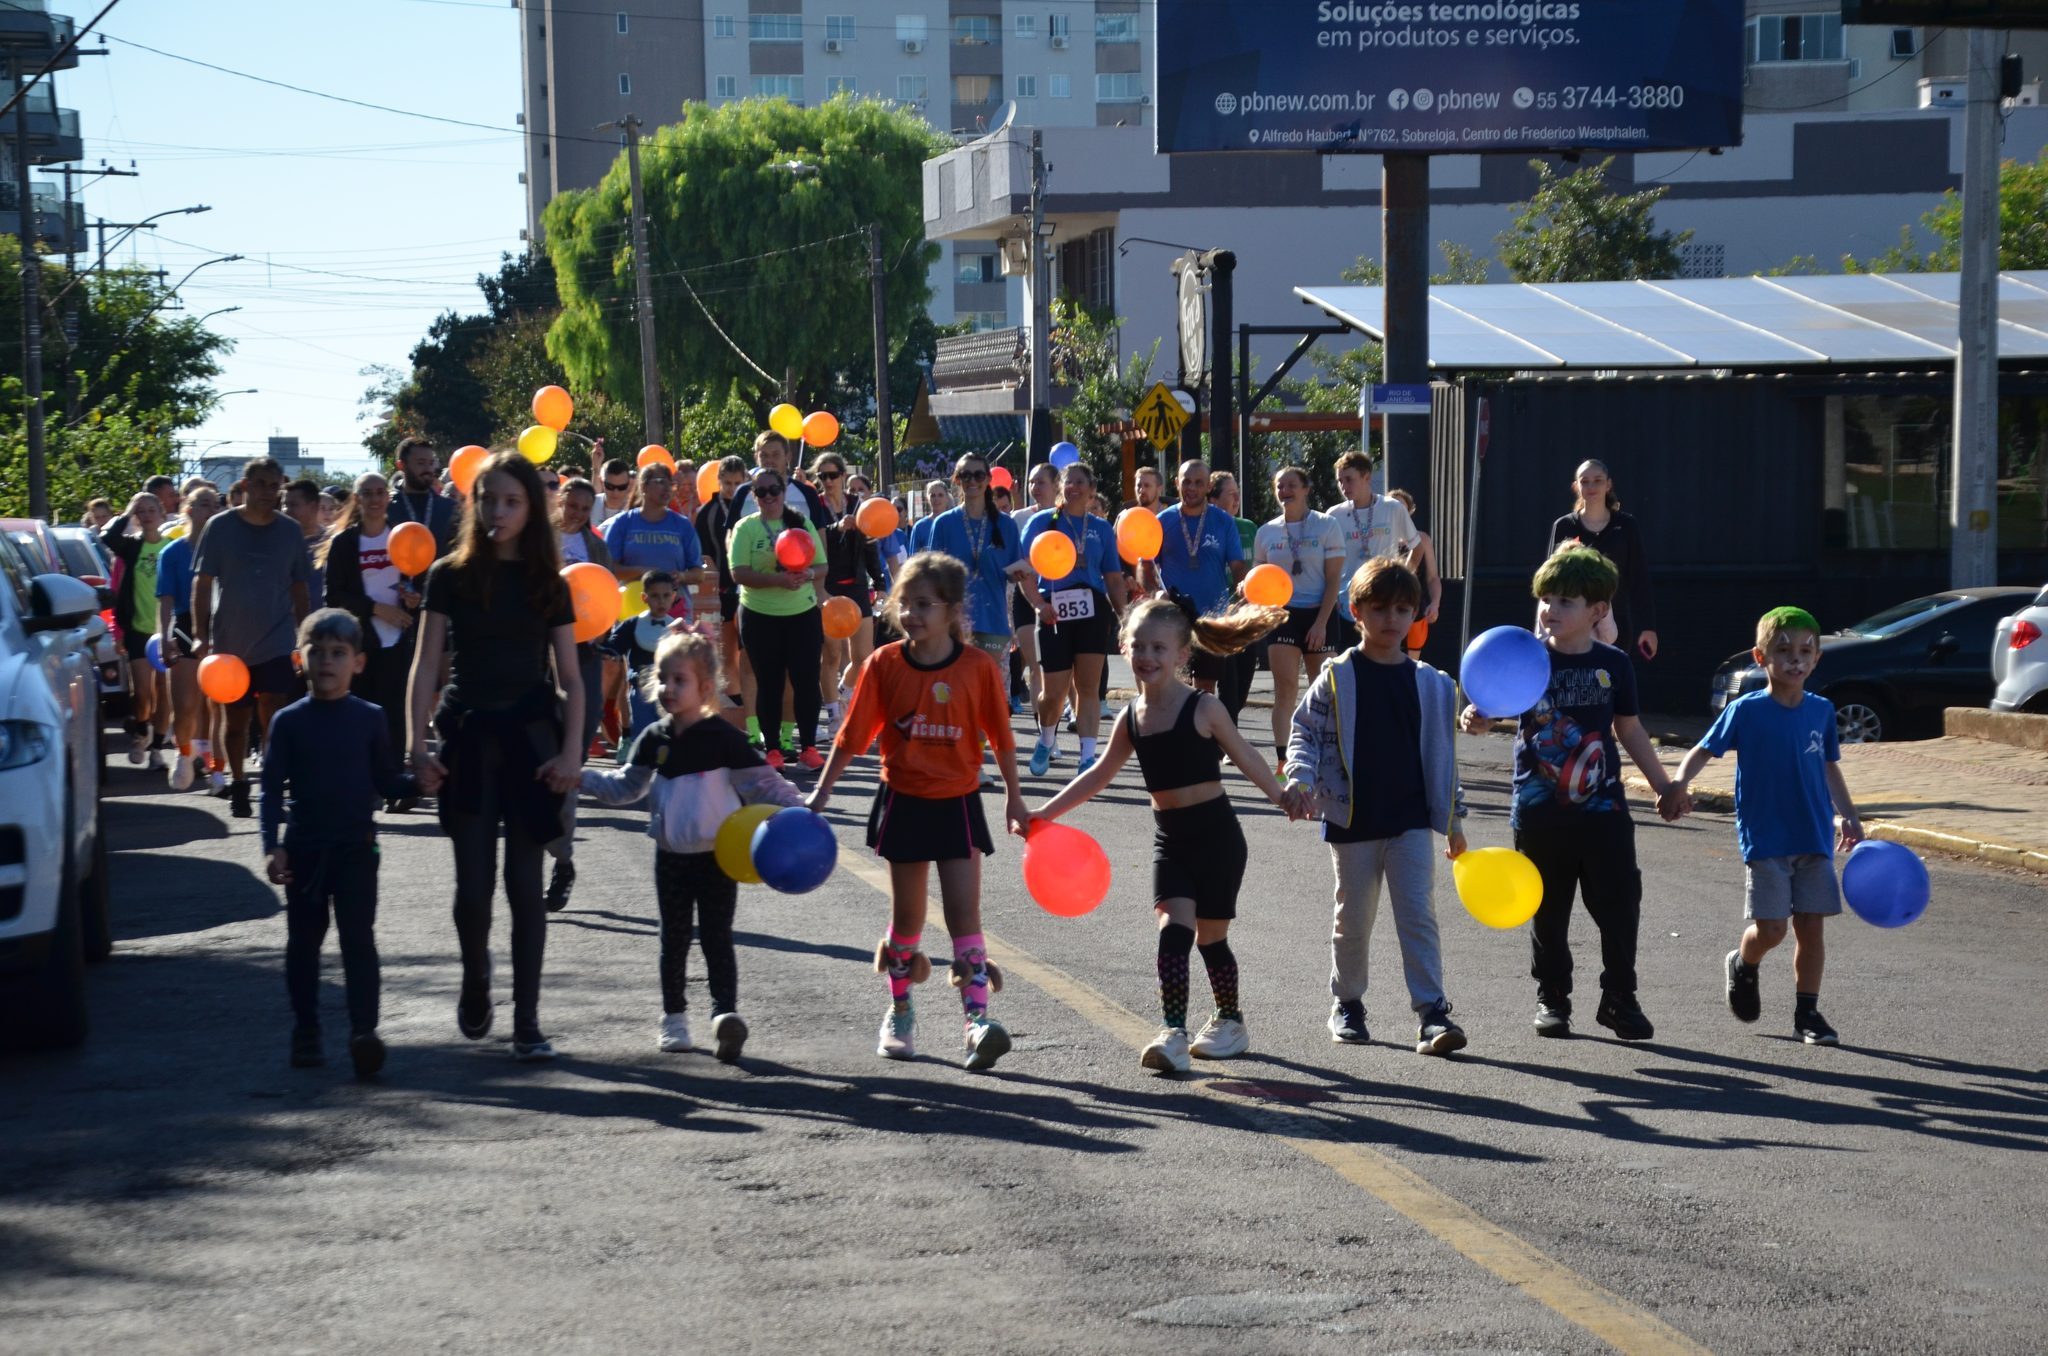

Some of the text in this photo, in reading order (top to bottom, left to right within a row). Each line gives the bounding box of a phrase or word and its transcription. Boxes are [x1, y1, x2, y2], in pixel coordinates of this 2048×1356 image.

[1317, 0, 1580, 27] Soluções tecnológicas
[1317, 24, 1580, 51] em produtos e serviços.
[1241, 90, 1376, 116] pbnew.com.br
[1437, 89, 1501, 114] pbnew
[1537, 85, 1684, 109] 55 3744-3880
[1262, 129, 1304, 143] Alfredo
[1402, 128, 1459, 145] Sobreloja,
[1462, 128, 1501, 142] Centro
[1504, 127, 1519, 140] de
[1521, 127, 1576, 141] Frederico
[1579, 126, 1649, 141] Westphalen.
[1058, 600, 1089, 618] 853
[1277, 636, 1295, 644] RUN
